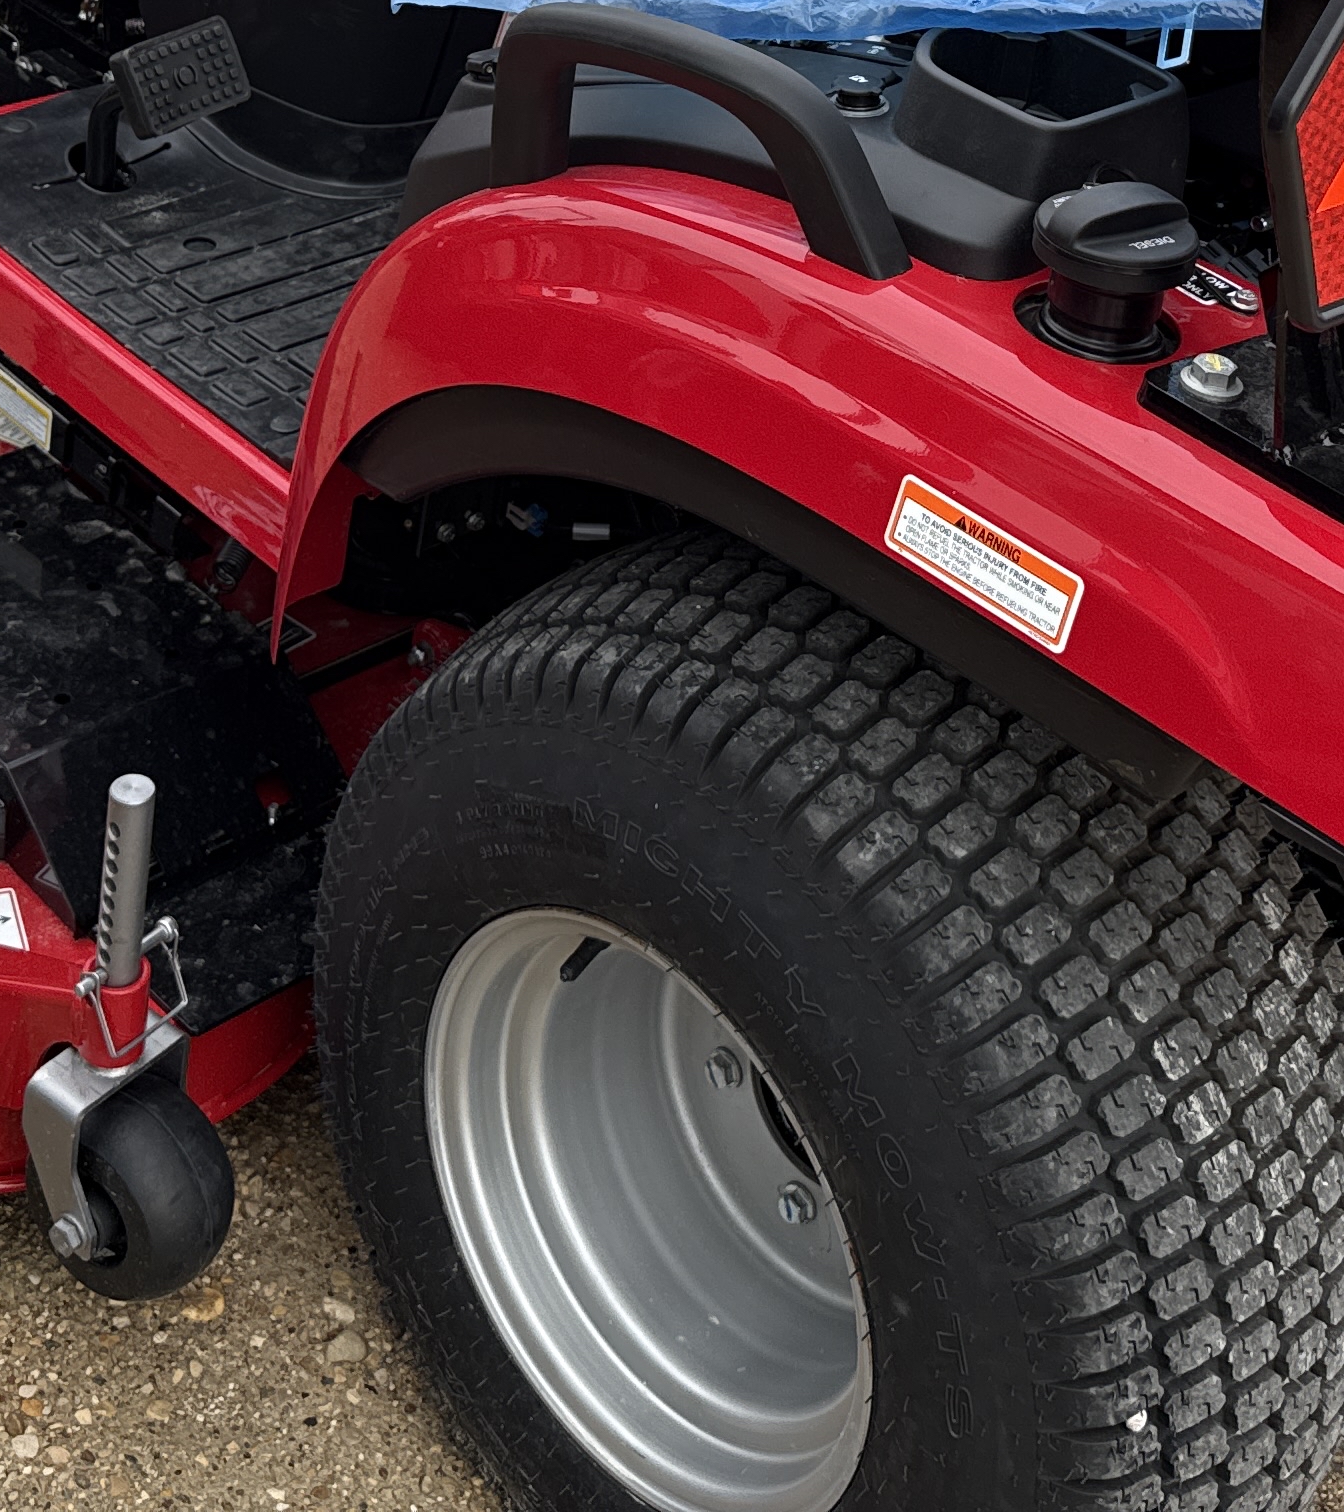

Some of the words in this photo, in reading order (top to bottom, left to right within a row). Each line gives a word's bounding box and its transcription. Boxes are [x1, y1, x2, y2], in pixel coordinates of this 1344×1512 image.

[902, 533, 924, 552] ALWAYS
[923, 546, 939, 561] STOP
[939, 556, 950, 568] THE
[950, 563, 972, 582] ENGINE
[972, 576, 995, 596] BEFORE
[995, 590, 1028, 617] REFUELING
[1027, 611, 1055, 634] TRACTOR
[907, 515, 917, 527] DO
[916, 521, 928, 534] NOT
[928, 528, 950, 548] REFUEL
[950, 542, 962, 555] THE
[962, 549, 988, 571] TRACTOR
[988, 565, 1007, 583] WHILE
[1007, 576, 1034, 599] SMOKING
[1034, 594, 1044, 606] OR
[1044, 600, 1061, 616] NEAR
[920, 512, 930, 524] TO
[930, 518, 952, 537] AVOID
[952, 532, 982, 557] SERIOUS
[982, 551, 1009, 573] INJURY
[1008, 567, 1030, 586] FROM
[1029, 580, 1047, 597] FIRE
[966, 520, 1022, 564] WARNING
[573, 797, 826, 1018] MIGHTY
[832, 1053, 974, 1439] MOW-TS
